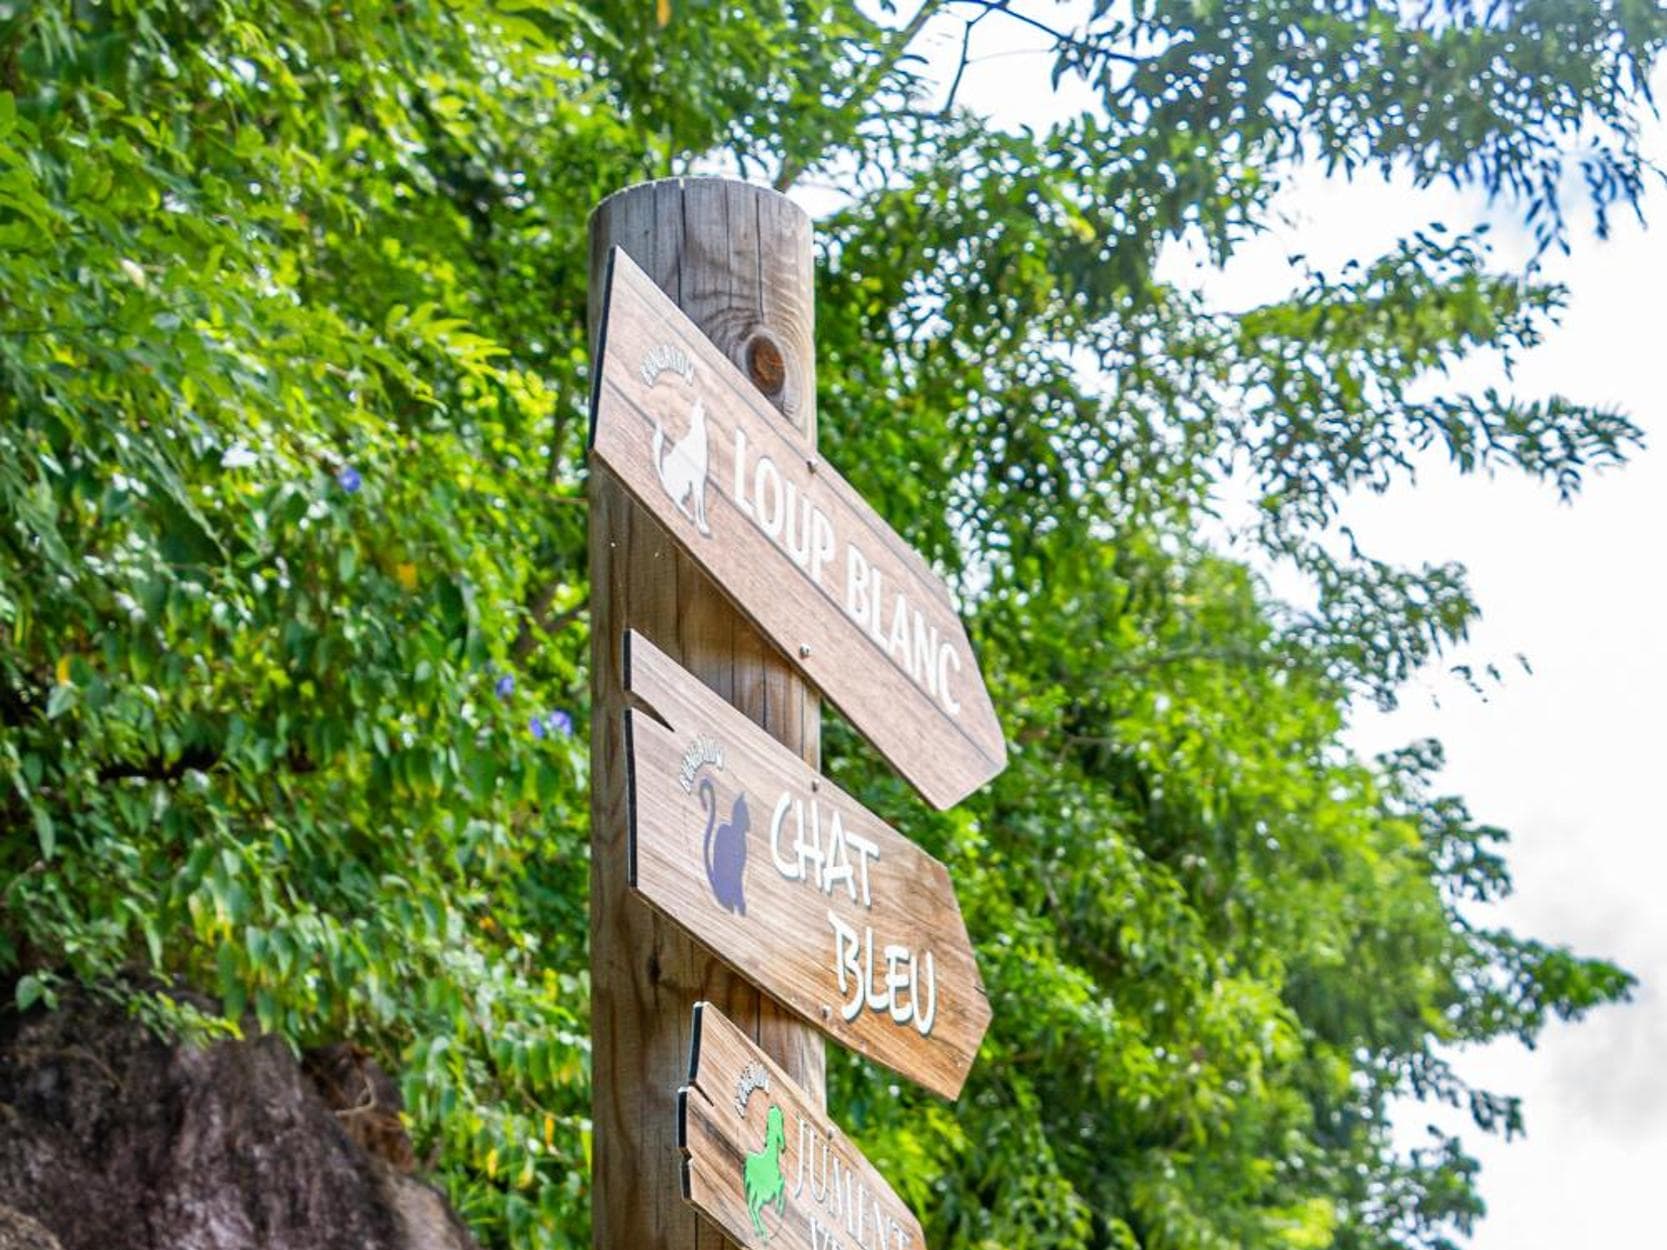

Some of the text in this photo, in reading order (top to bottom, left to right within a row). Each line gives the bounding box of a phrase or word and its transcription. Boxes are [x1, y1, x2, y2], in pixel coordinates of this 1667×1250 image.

[733, 428, 961, 714] LOUP BLANC
[770, 791, 880, 906] CHAT
[828, 911, 935, 1035] BLEU
